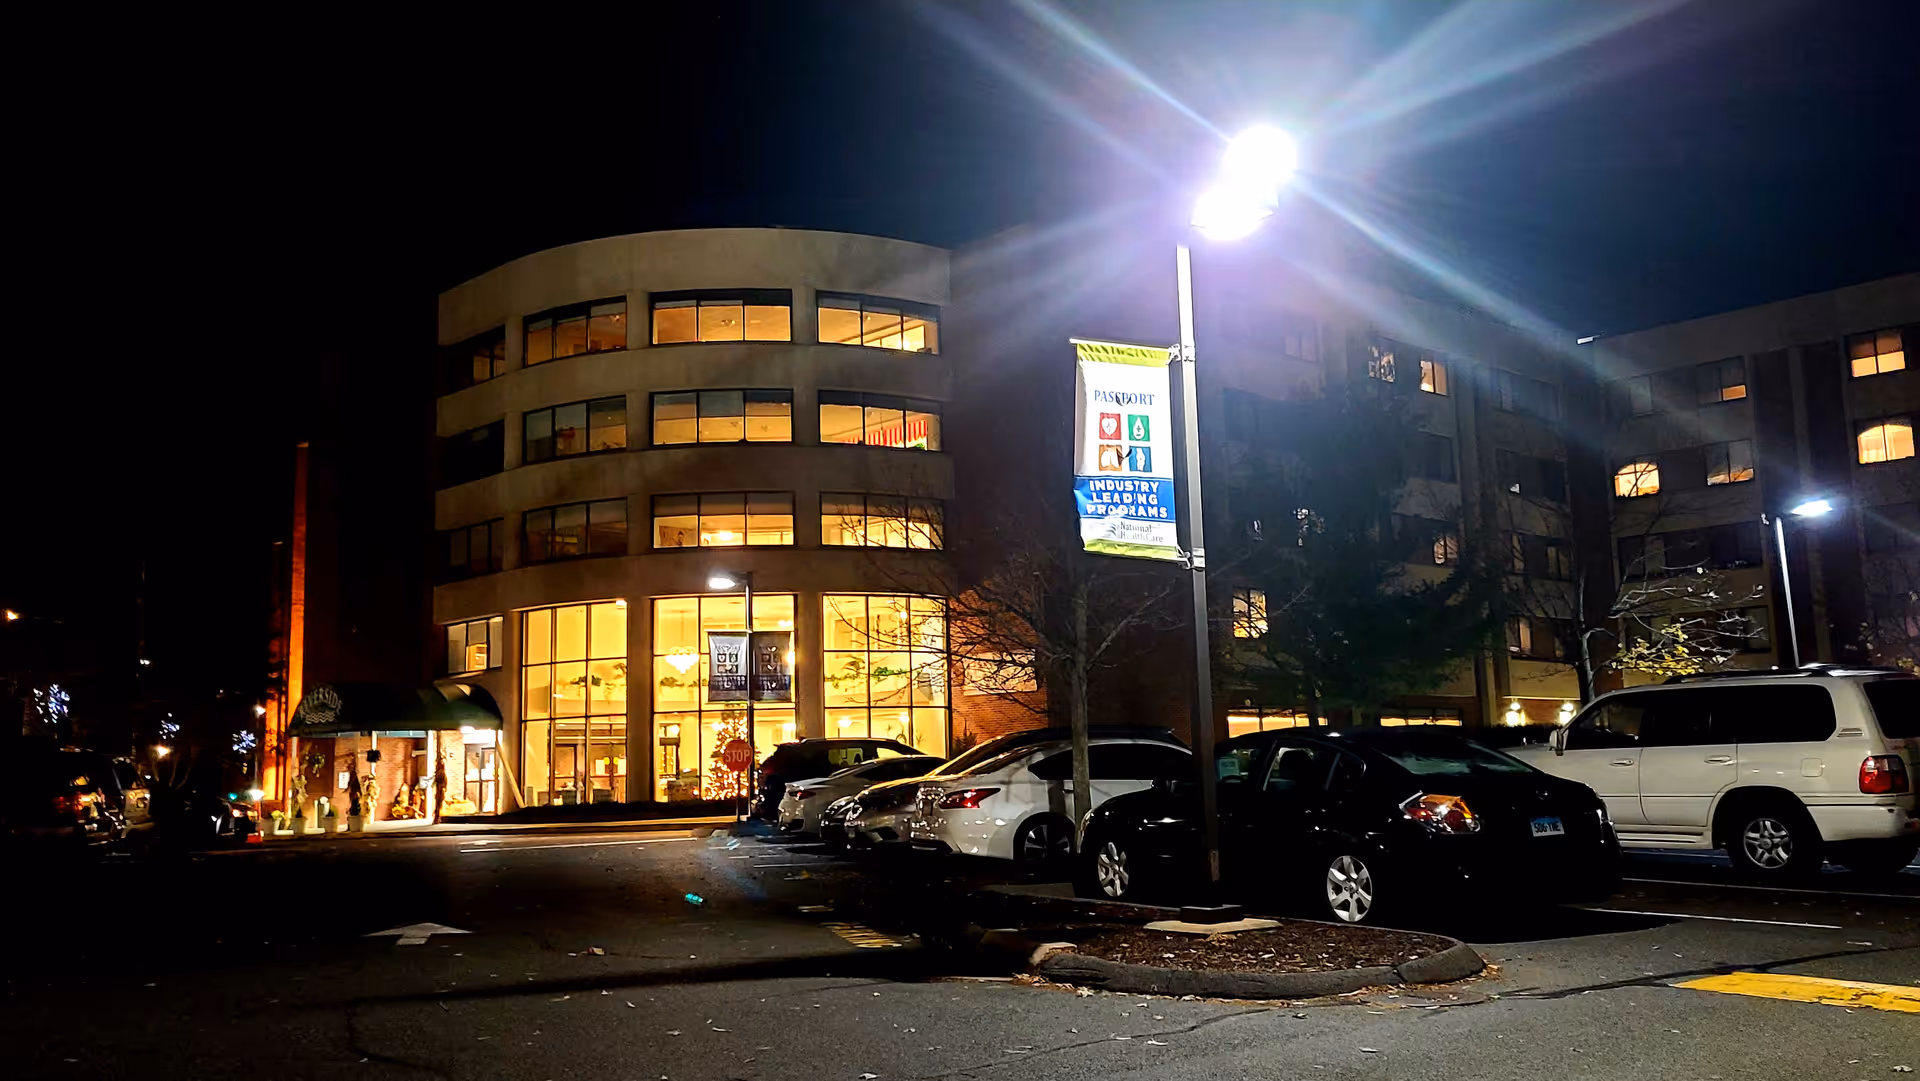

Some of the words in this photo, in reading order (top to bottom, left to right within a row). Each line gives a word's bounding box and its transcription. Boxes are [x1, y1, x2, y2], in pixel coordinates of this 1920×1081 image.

[1095, 389, 1154, 406] PASSPORT
[1089, 479, 1159, 493] INDUSTRY
[1092, 491, 1158, 505] LEADING
[1086, 503, 1168, 518] PROGRAMS
[1120, 521, 1152, 533] National
[725, 749, 751, 762] STOP
